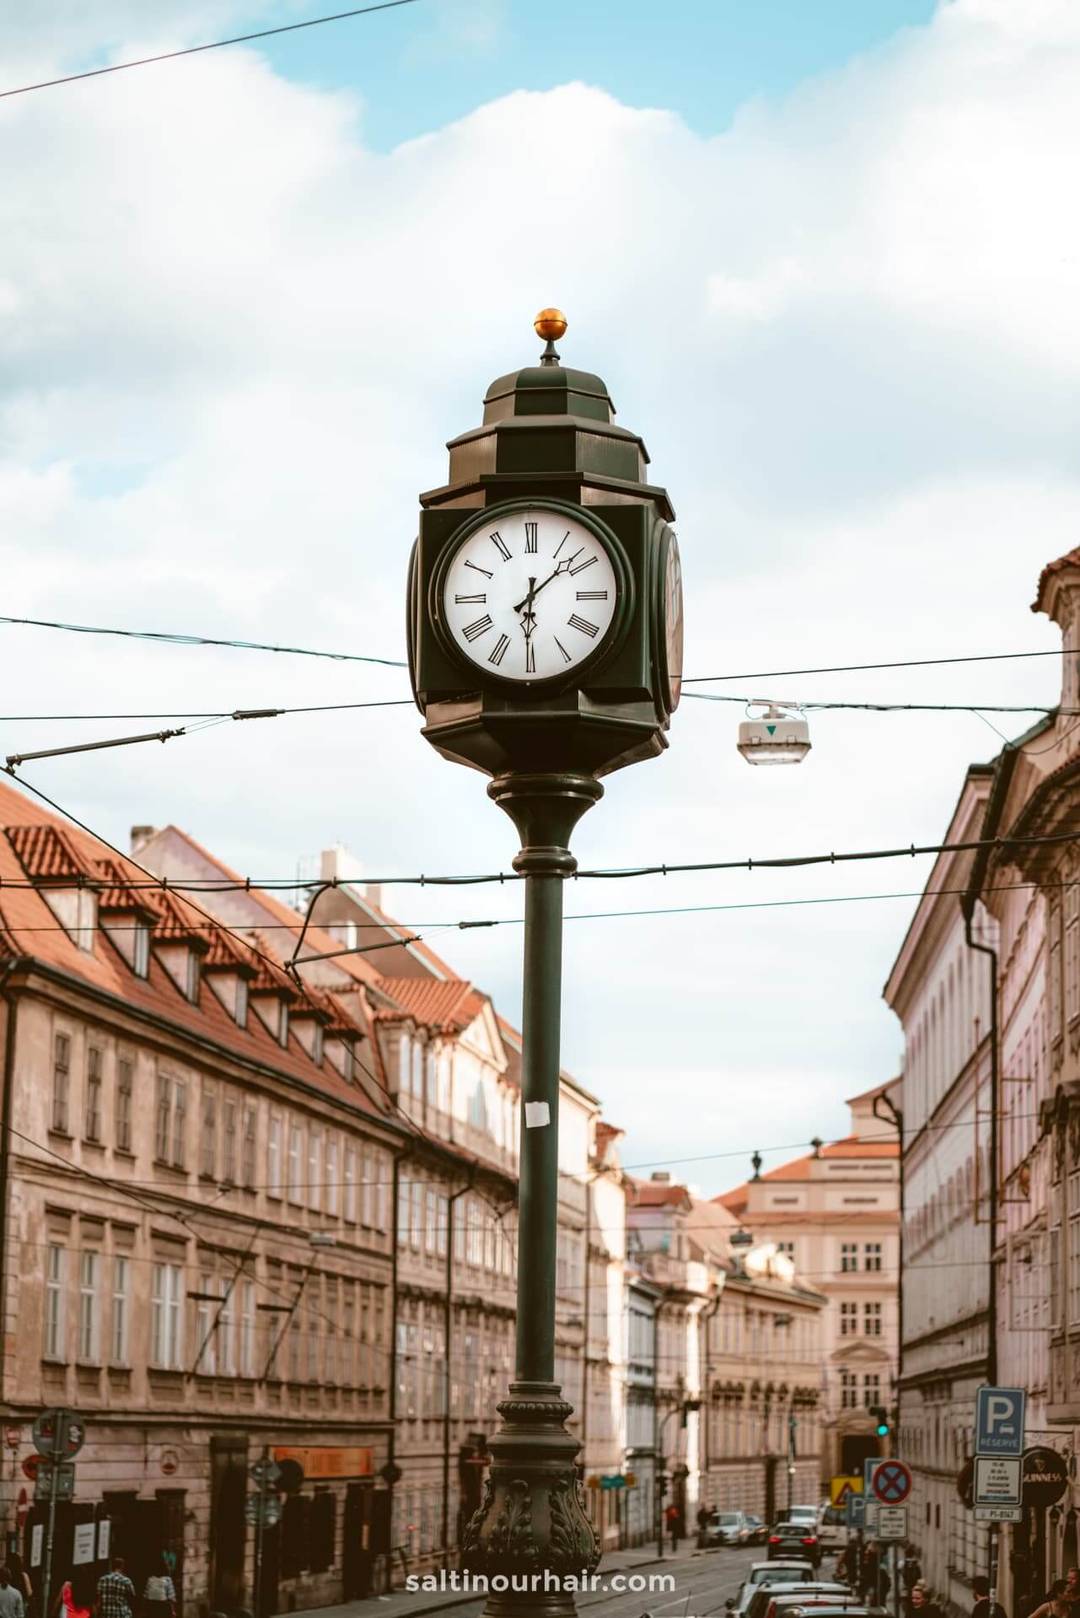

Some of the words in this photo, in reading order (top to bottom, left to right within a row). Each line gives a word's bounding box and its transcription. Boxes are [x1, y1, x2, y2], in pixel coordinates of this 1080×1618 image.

[489, 531, 513, 562] XI
[525, 522, 538, 553] XII
[464, 559, 494, 579] X
[569, 556, 599, 576] II
[454, 593, 487, 604] IX
[576, 591, 608, 600] III
[461, 614, 495, 643] VIII
[488, 633, 512, 666] VII
[986, 1396, 1014, 1434] P
